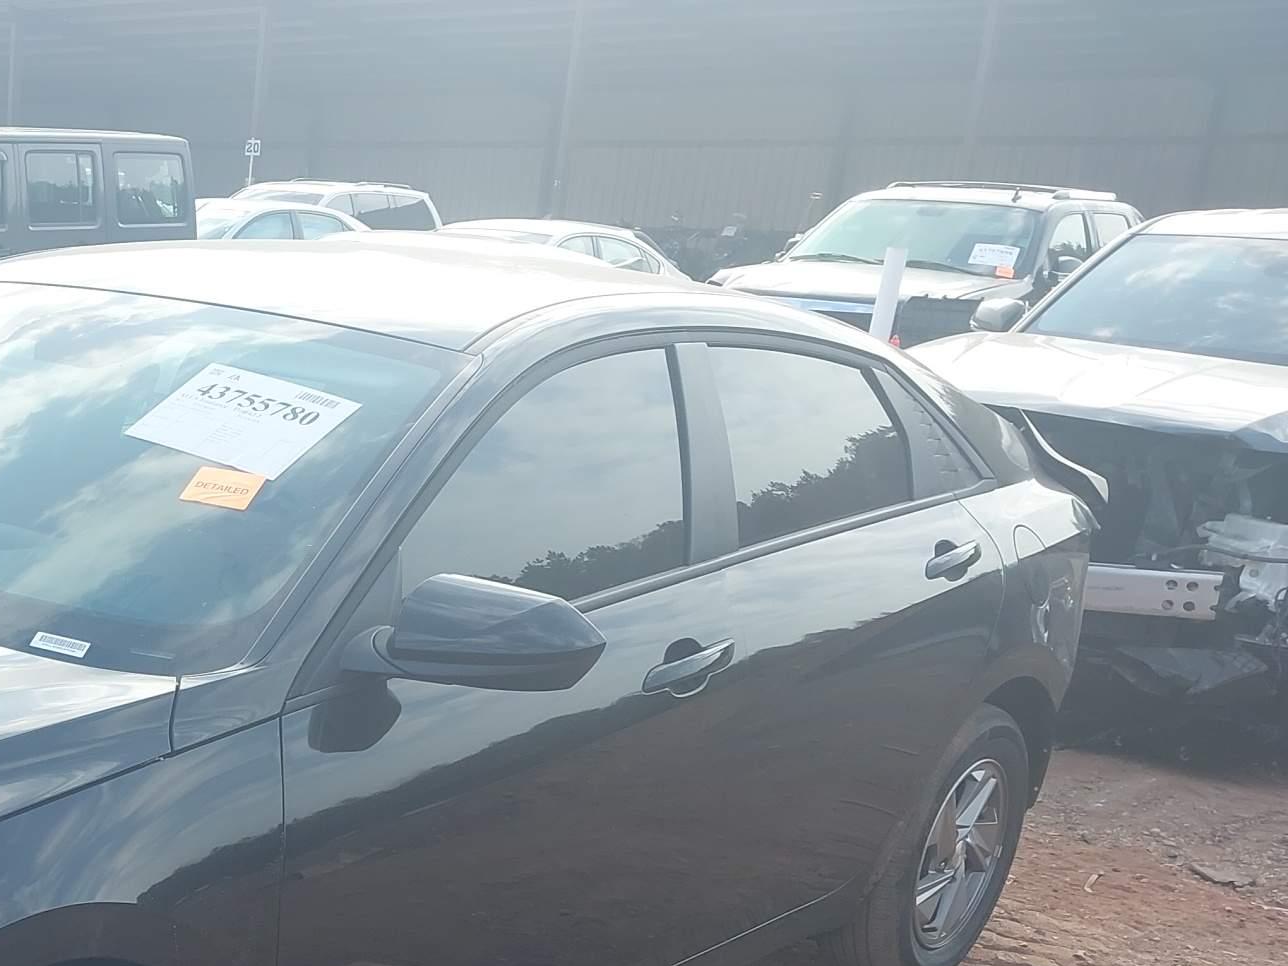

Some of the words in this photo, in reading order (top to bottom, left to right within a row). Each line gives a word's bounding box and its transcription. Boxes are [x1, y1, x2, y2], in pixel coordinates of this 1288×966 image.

[246, 142, 259, 153] 20
[197, 383, 320, 425] 43755780
[194, 480, 250, 496] DETAILED
